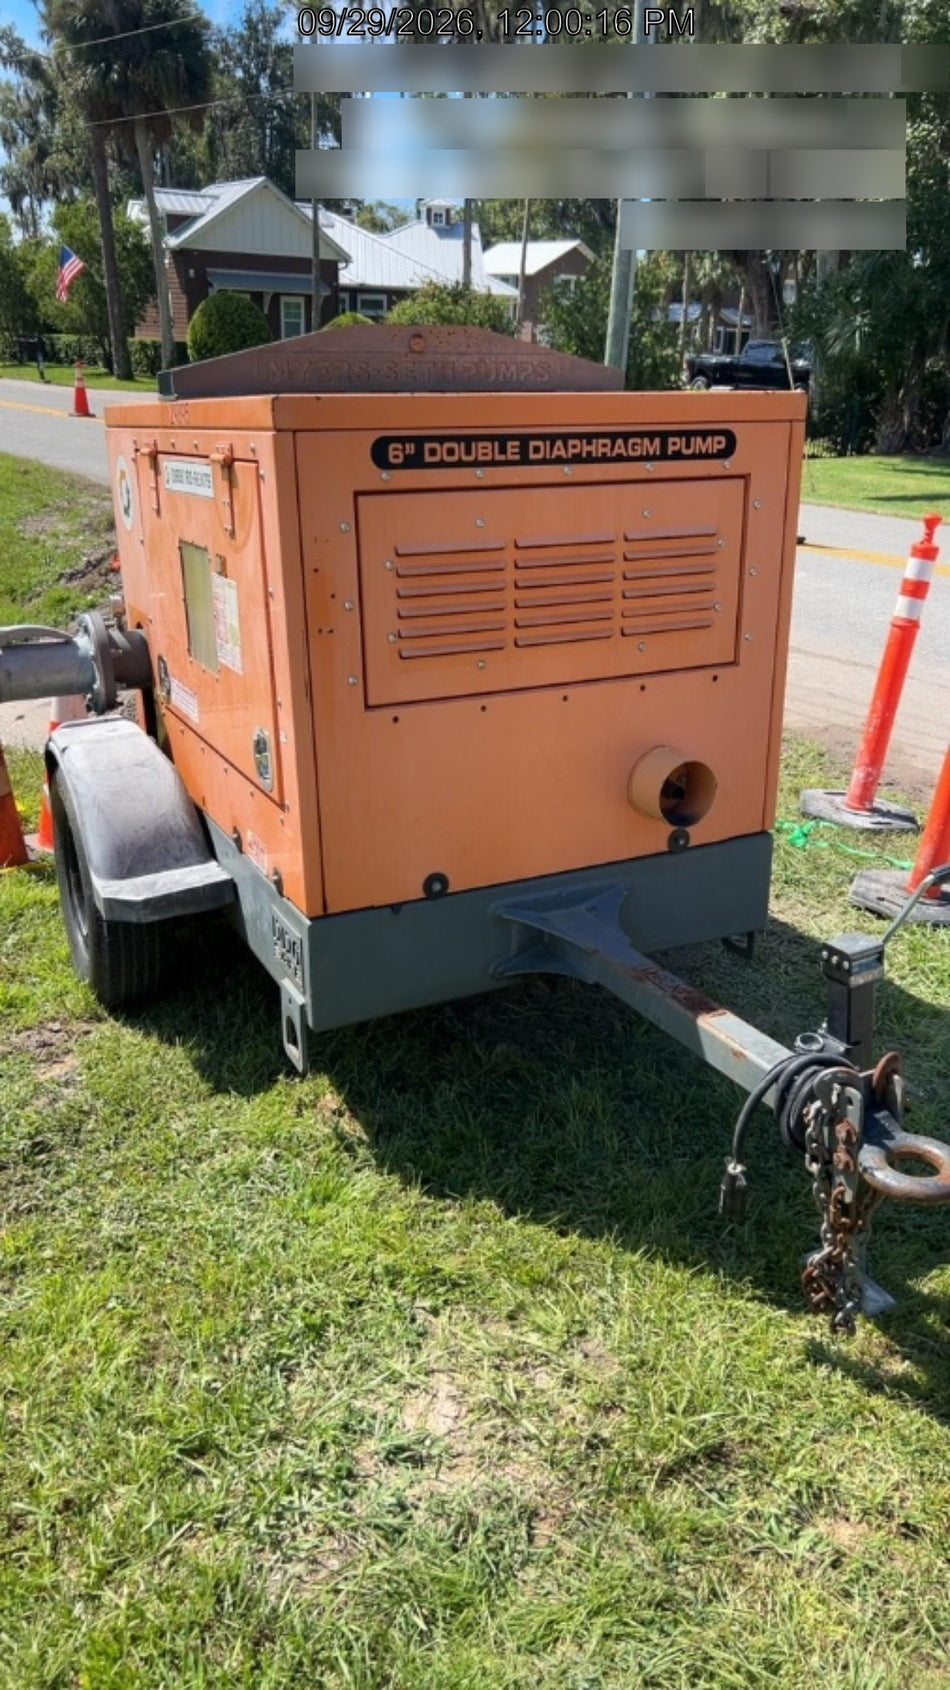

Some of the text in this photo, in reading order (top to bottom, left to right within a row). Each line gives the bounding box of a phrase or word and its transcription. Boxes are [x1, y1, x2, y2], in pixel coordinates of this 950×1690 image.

[461, 360, 550, 383] PUMPS
[424, 440, 520, 462] DOUBLE
[529, 437, 660, 461] DIAPHRAGM
[667, 435, 726, 456] PUMP
